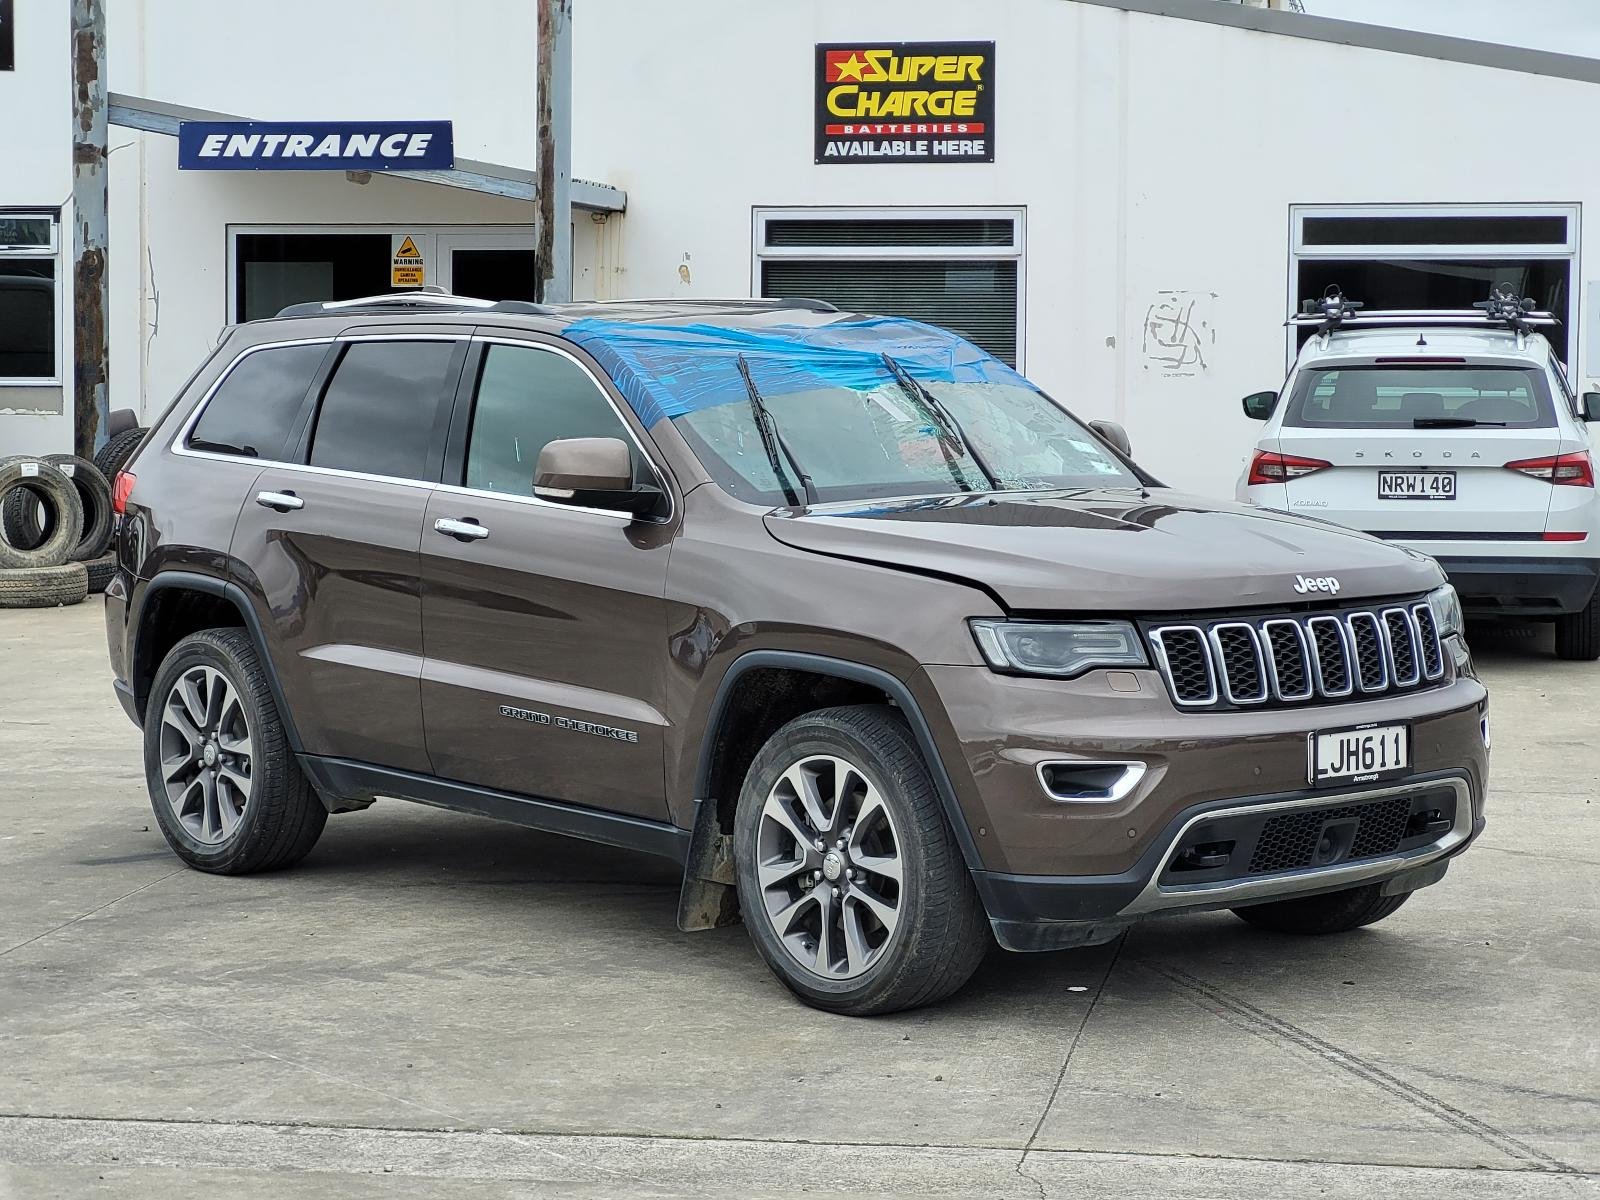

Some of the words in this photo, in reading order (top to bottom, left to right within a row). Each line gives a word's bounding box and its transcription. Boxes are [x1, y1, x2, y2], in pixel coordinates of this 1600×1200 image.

[863, 49, 984, 82] SUPER
[826, 85, 977, 117] CHARGE
[844, 124, 968, 134] BATTERIES
[198, 133, 432, 157] ENTRANCE
[824, 140, 928, 156] AVAILABLE
[933, 140, 985, 155] HERE
[1355, 450, 1481, 458] SKODA
[1382, 475, 1453, 493] NRW140
[1293, 574, 1340, 595] Jeep
[499, 705, 550, 724] GRAND
[554, 717, 639, 743] CHEROKEE
